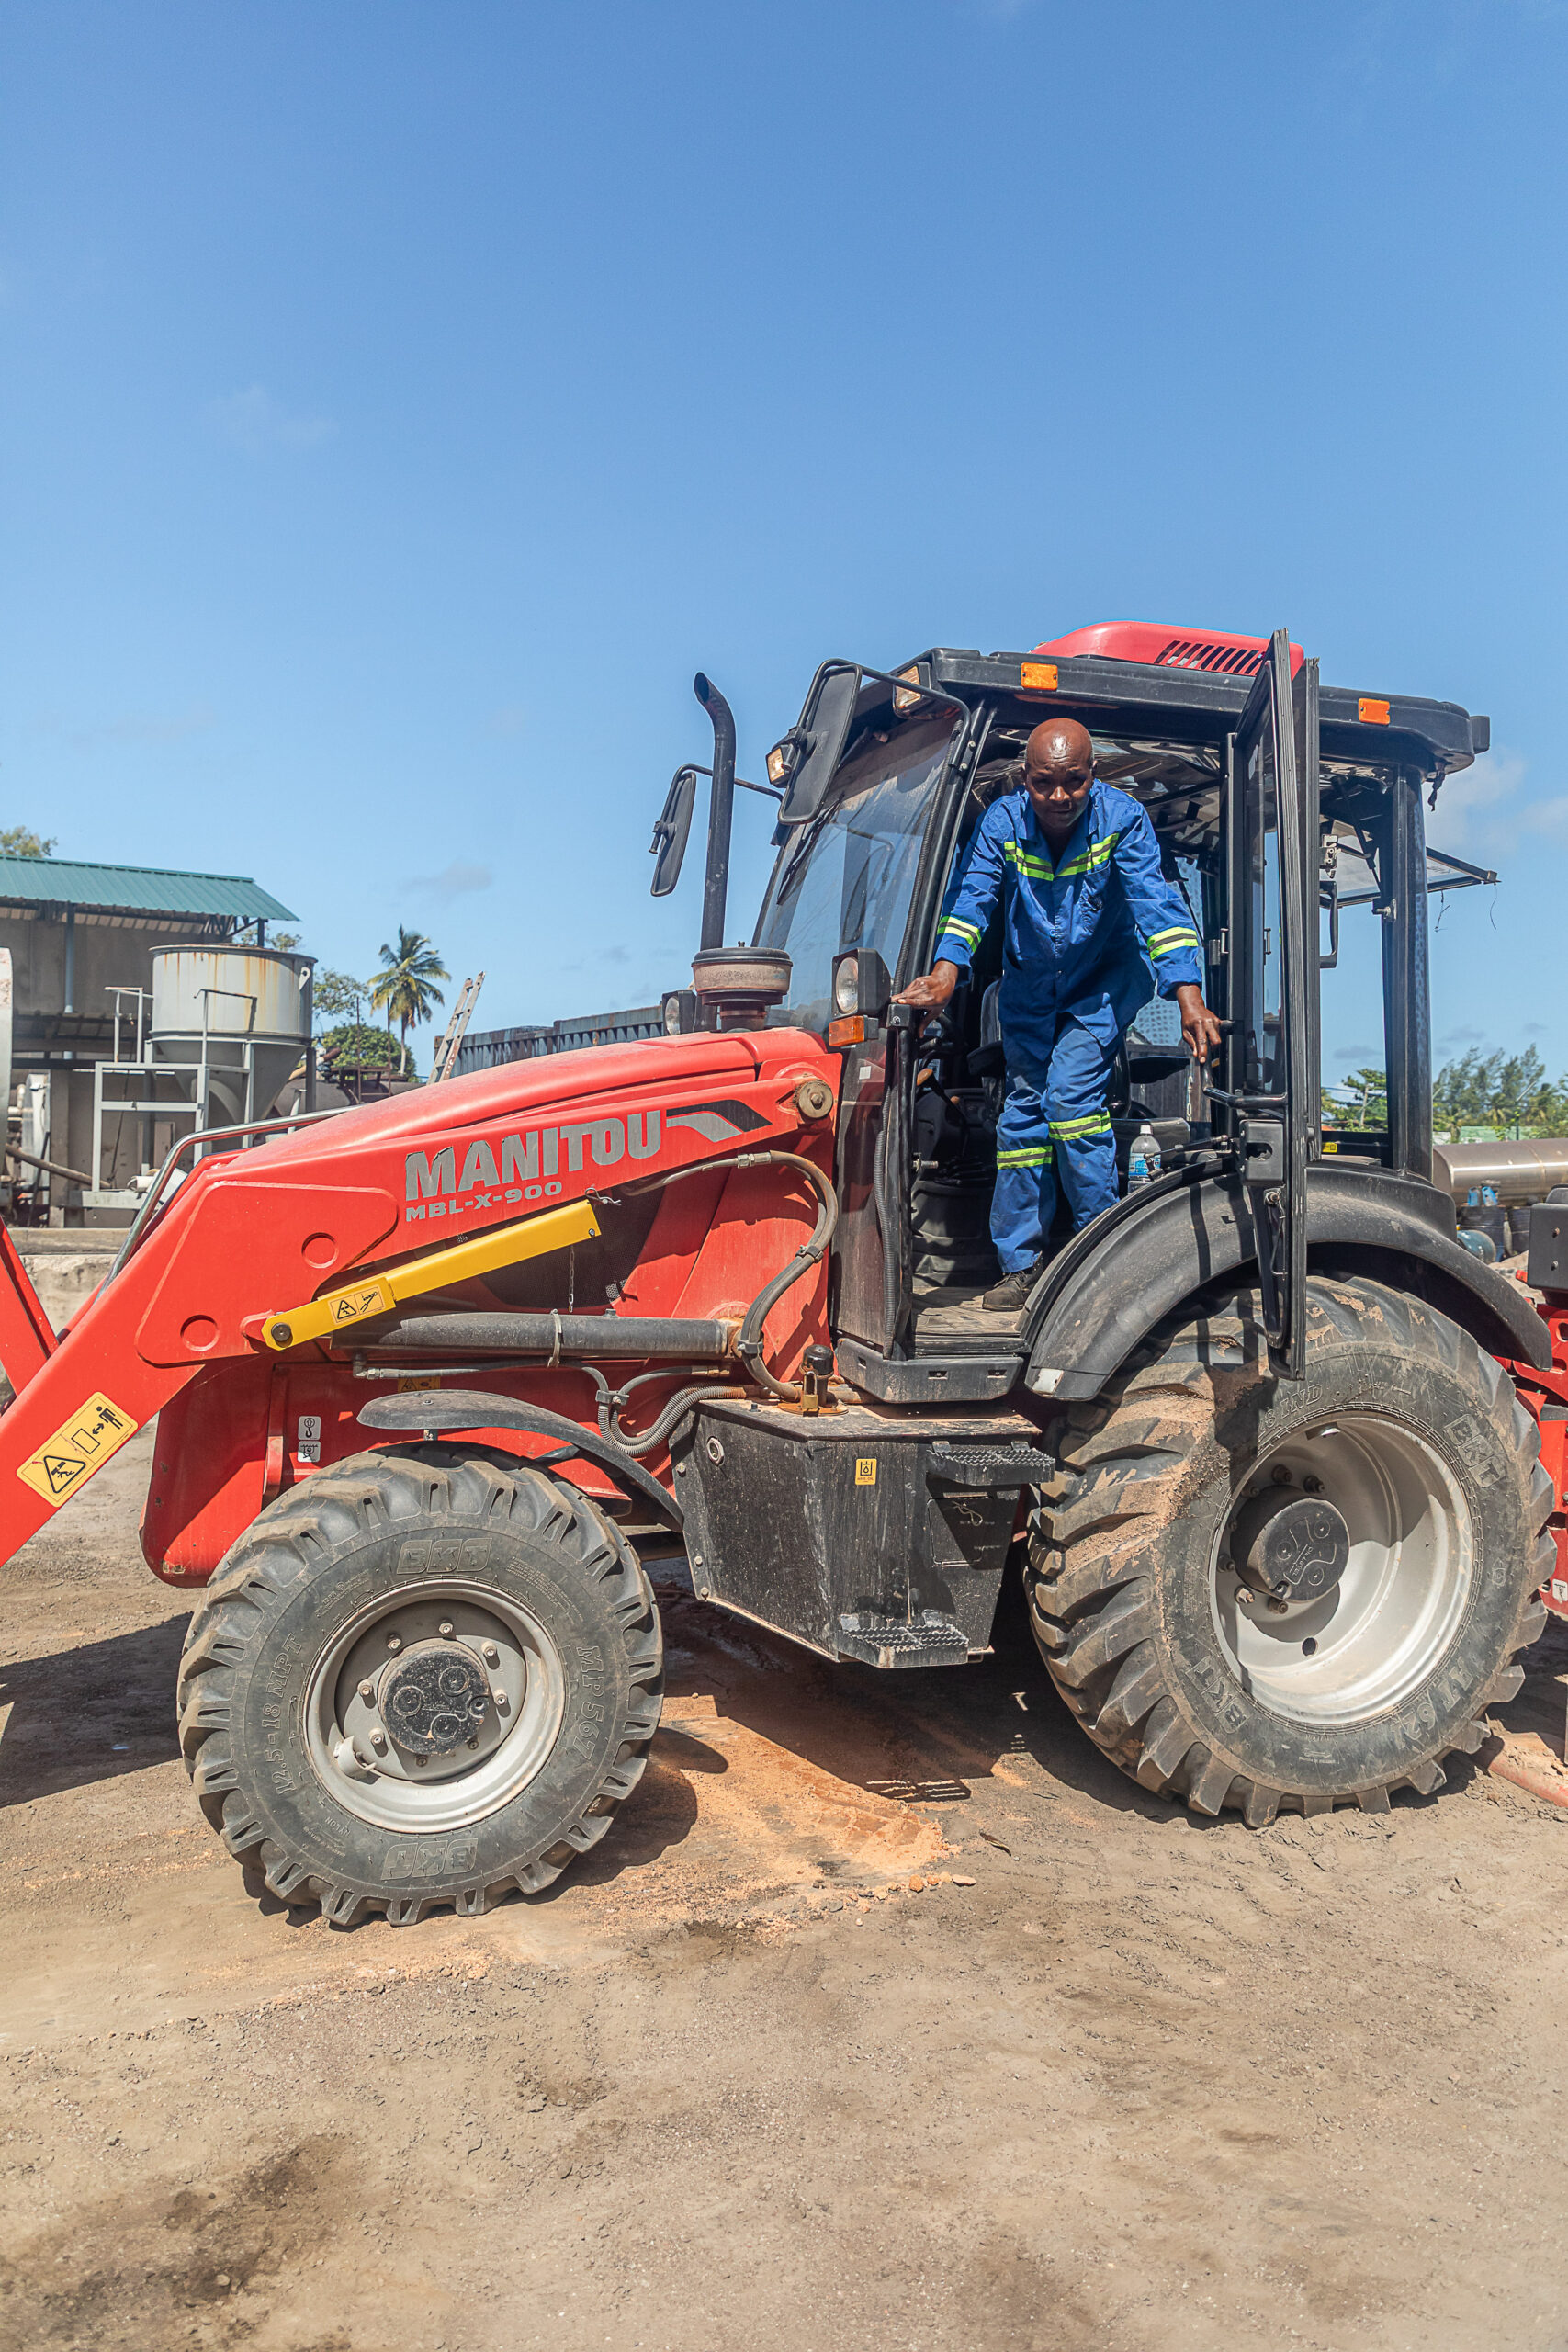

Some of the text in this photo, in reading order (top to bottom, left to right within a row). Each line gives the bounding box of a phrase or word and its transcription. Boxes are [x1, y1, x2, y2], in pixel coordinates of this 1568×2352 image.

[405, 1109, 661, 1202] MANITOU
[405, 1181, 562, 1223] MBL-X-900
[1447, 1419, 1504, 1486] BKT
[400, 1541, 491, 1571] BKT
[263, 1633, 303, 1795] 12.5-18 MPT
[571, 1645, 604, 1761] MP 567
[1188, 1657, 1247, 1734] BKT
[382, 1841, 477, 1877] BKT
